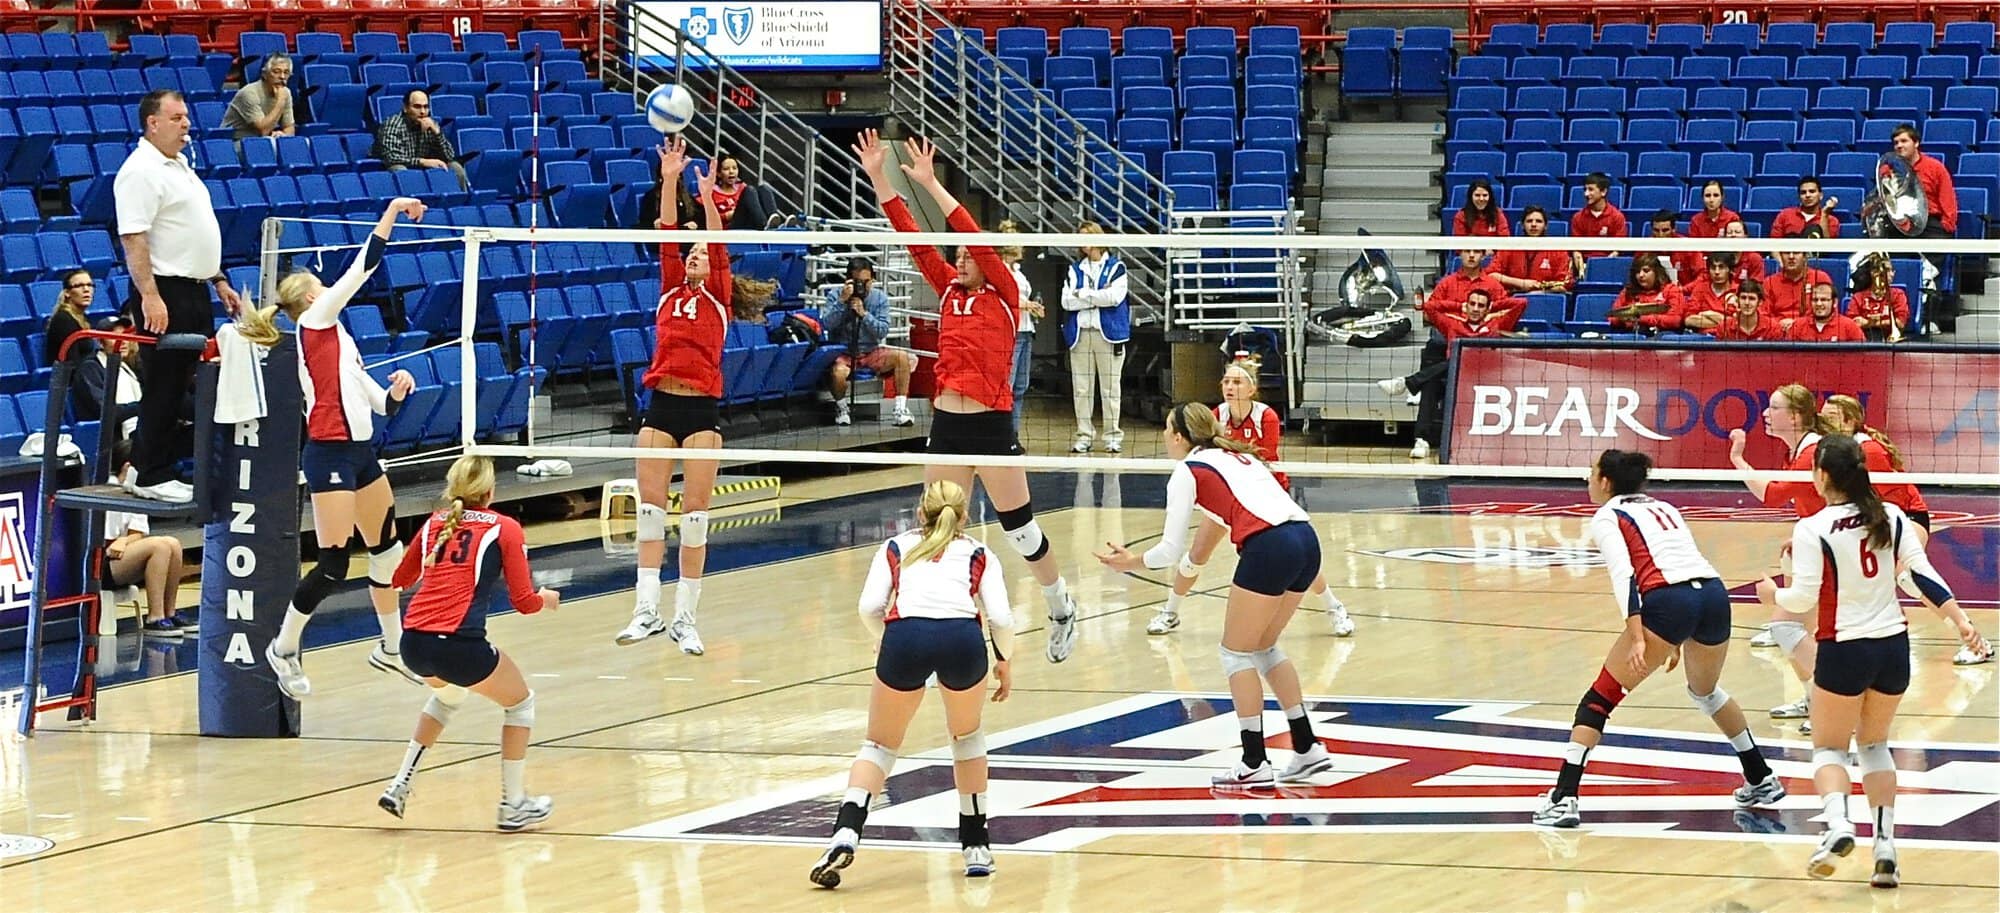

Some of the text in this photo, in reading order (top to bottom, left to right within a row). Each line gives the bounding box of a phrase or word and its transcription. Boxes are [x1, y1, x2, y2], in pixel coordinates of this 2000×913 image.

[761, 7, 824, 18] BlueCross
[1722, 10, 1748, 25] 20
[452, 16, 472, 37] 18
[761, 21, 829, 33] BlueShield
[761, 36, 825, 48] of Arizona
[672, 296, 698, 320] 14
[1468, 385, 1673, 441] BEAR
[1647, 507, 1679, 531] 11
[223, 419, 260, 665] RIZONA
[435, 529, 473, 564] 13
[1859, 533, 1879, 579] 6
